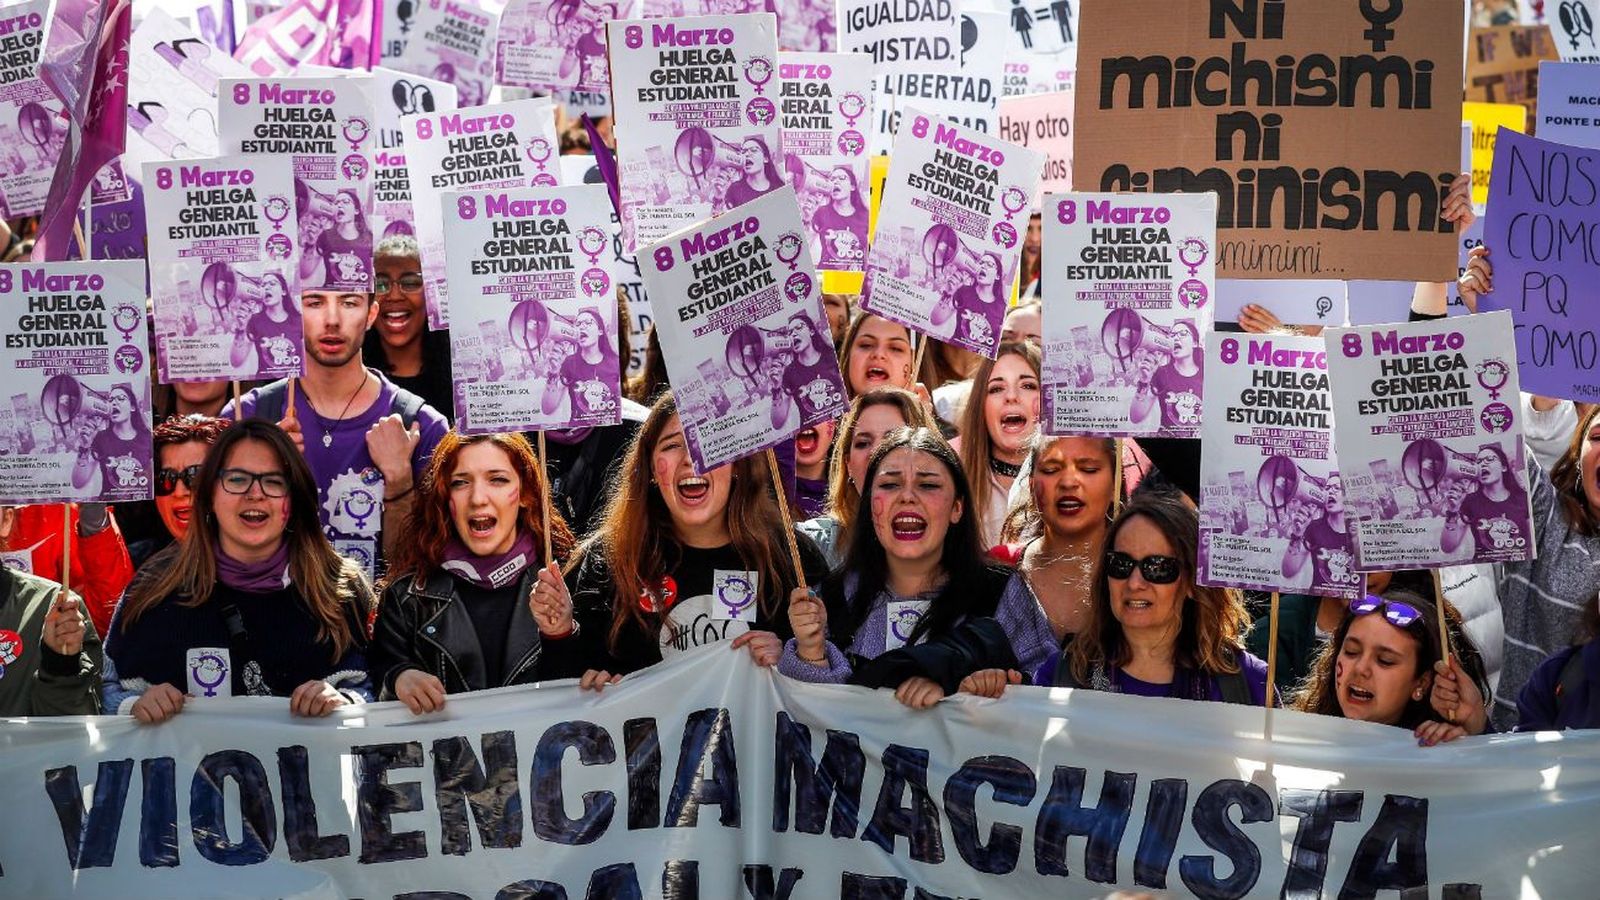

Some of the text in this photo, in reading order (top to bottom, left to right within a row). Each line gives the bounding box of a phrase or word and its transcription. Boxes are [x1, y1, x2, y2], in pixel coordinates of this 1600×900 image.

[847, 0, 955, 34] IGUALDAD,
[624, 23, 735, 49] 8 Marzo
[659, 48, 736, 67] HUELGA
[852, 37, 955, 64] MISTAD.
[649, 66, 739, 86] GENERAL
[1099, 41, 1435, 110] michismi
[233, 83, 336, 105] 8 Marzo
[637, 84, 740, 103] ESTUDIANTIL
[884, 73, 997, 109] LIBERTAD,
[264, 107, 336, 123] HUELGA
[415, 113, 515, 140] 8 Marzo
[782, 116, 833, 129] IANTIL
[1545, 116, 1589, 126] PONTE
[254, 124, 337, 139] GENERAL
[448, 131, 519, 154] HUELGA
[912, 115, 930, 139] 8
[933, 123, 1005, 167] Marzo
[999, 115, 1030, 148] Hay
[1035, 113, 1069, 139] otro
[1215, 111, 1283, 162] ni
[241, 140, 337, 154] ESTUDIANTIL
[441, 148, 522, 172] GENERAL
[933, 148, 999, 186] HUELGA
[156, 165, 255, 190] 8 Marzo
[431, 164, 525, 188] ESTUDIANTIL
[922, 162, 995, 202] GENERAL
[1508, 145, 1597, 207] NOS
[186, 188, 257, 206] HUELGA
[457, 193, 567, 220] 8 Marzo
[907, 173, 992, 216] ESTUDIANTIL
[179, 205, 259, 224] GENERAL
[1057, 200, 1171, 224] 8 Marzo
[168, 222, 260, 240] ESTUDIANTIL
[492, 218, 571, 239] HUELGA
[1091, 227, 1172, 244] HUELGA
[483, 237, 573, 258] GENERAL
[653, 245, 675, 272] 8
[679, 215, 760, 263] Marzo
[1080, 246, 1172, 263] GENERAL
[471, 255, 575, 275] ESTUDIANTIL
[691, 235, 768, 280] HUELGA
[0, 268, 104, 293] 8 Marzo
[687, 252, 773, 301] GENERAL
[1066, 265, 1172, 280] ESTUDIANTIL
[28, 295, 106, 313] HUELGA
[677, 270, 777, 323] ESTUDIANTIL
[1522, 271, 1568, 317] PQ
[18, 313, 107, 332] GENERAL
[5, 331, 108, 349] ESTUDIANTIL
[1220, 338, 1239, 364] 8
[1341, 330, 1465, 358] 8 Marzo
[1381, 352, 1468, 377] HUELGA
[1252, 369, 1329, 391] HUELGA
[1371, 372, 1471, 397] GENERAL
[1240, 388, 1331, 411] GENERAL
[1358, 391, 1474, 416] ESTUDIANTIL
[1226, 407, 1330, 428] ESTUDIANTIL
[45, 707, 741, 870] VIOLENCIA
